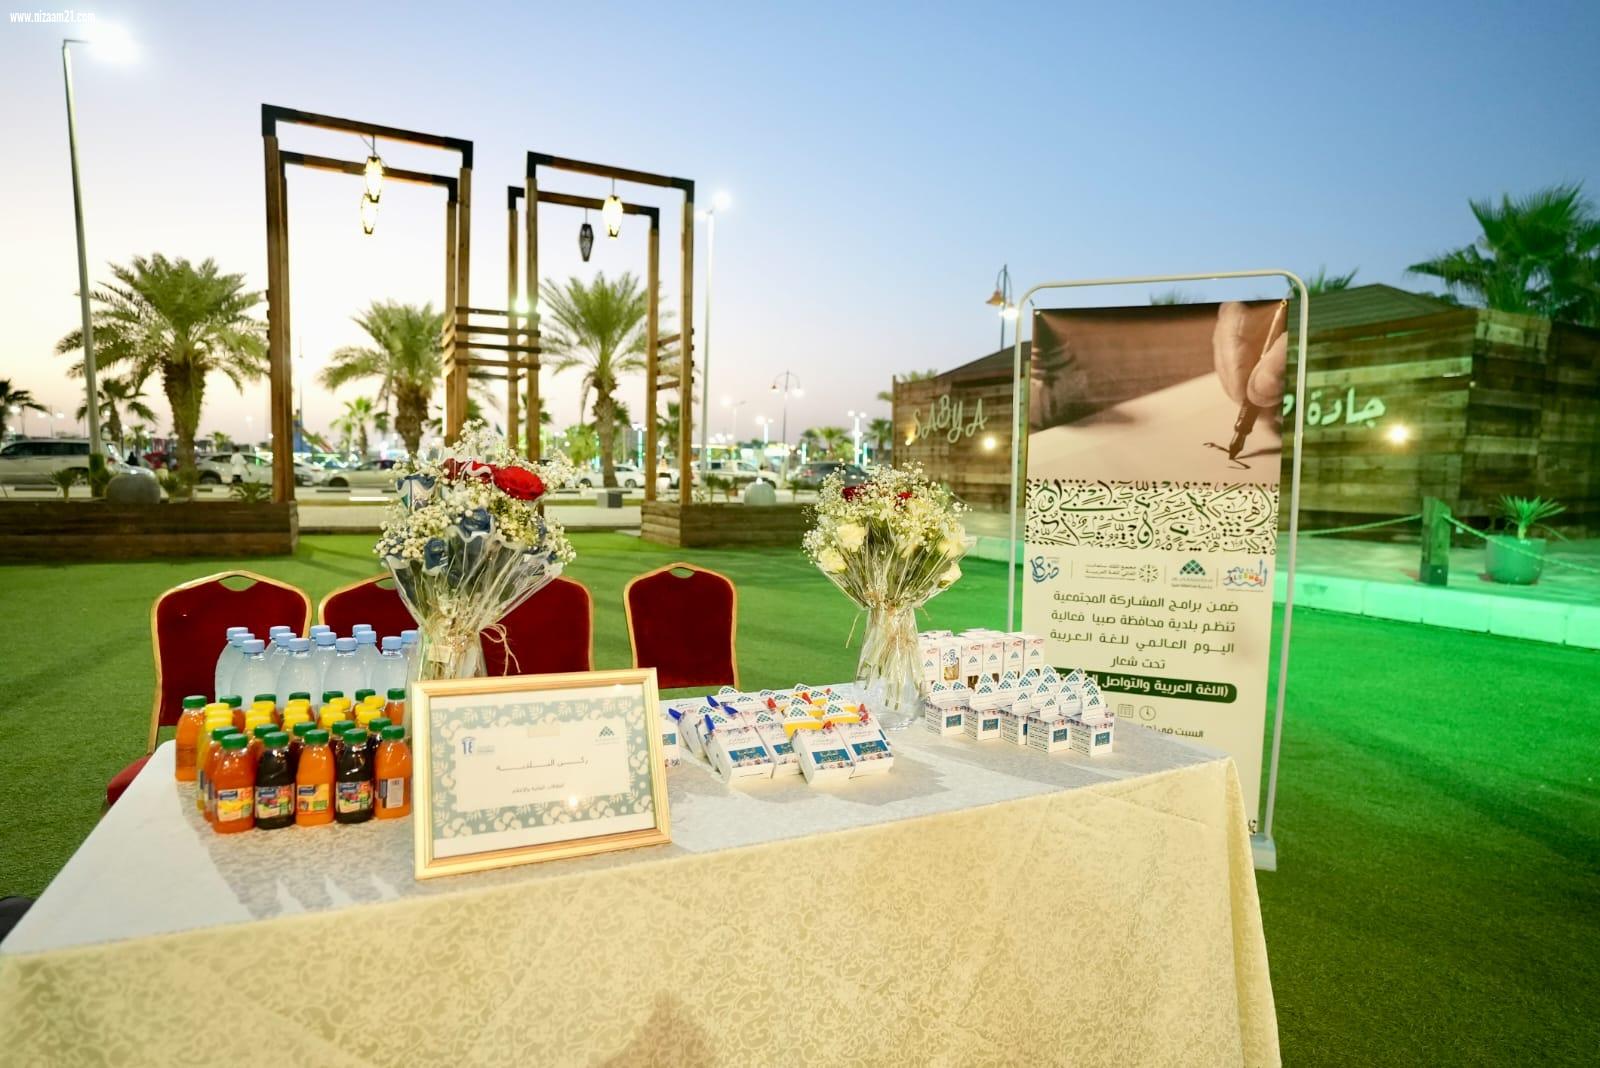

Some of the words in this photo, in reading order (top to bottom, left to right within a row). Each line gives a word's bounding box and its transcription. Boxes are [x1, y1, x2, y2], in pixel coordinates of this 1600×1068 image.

[912, 394, 989, 444] SABYA
[1052, 590, 1106, 605] المجتمعية
[1109, 594, 1165, 609] المشاركة
[1168, 598, 1202, 613] برامج
[1206, 602, 1239, 613] ضمن
[1050, 609, 1085, 623] فعالية
[1091, 612, 1116, 626] صبيا
[1119, 613, 1164, 629] محافظة
[1168, 617, 1198, 632] بلدية
[1201, 621, 1236, 634] تنظم
[1049, 628, 1093, 643] العربية
[1098, 633, 1129, 645] للغة
[1135, 637, 1187, 652] العالمي
[1193, 642, 1235, 655] اليوم
[1109, 655, 1138, 668] شعار
[1141, 658, 1166, 670] تحت
[1102, 675, 1151, 691] والتواصل
[1153, 680, 1193, 694] العربية
